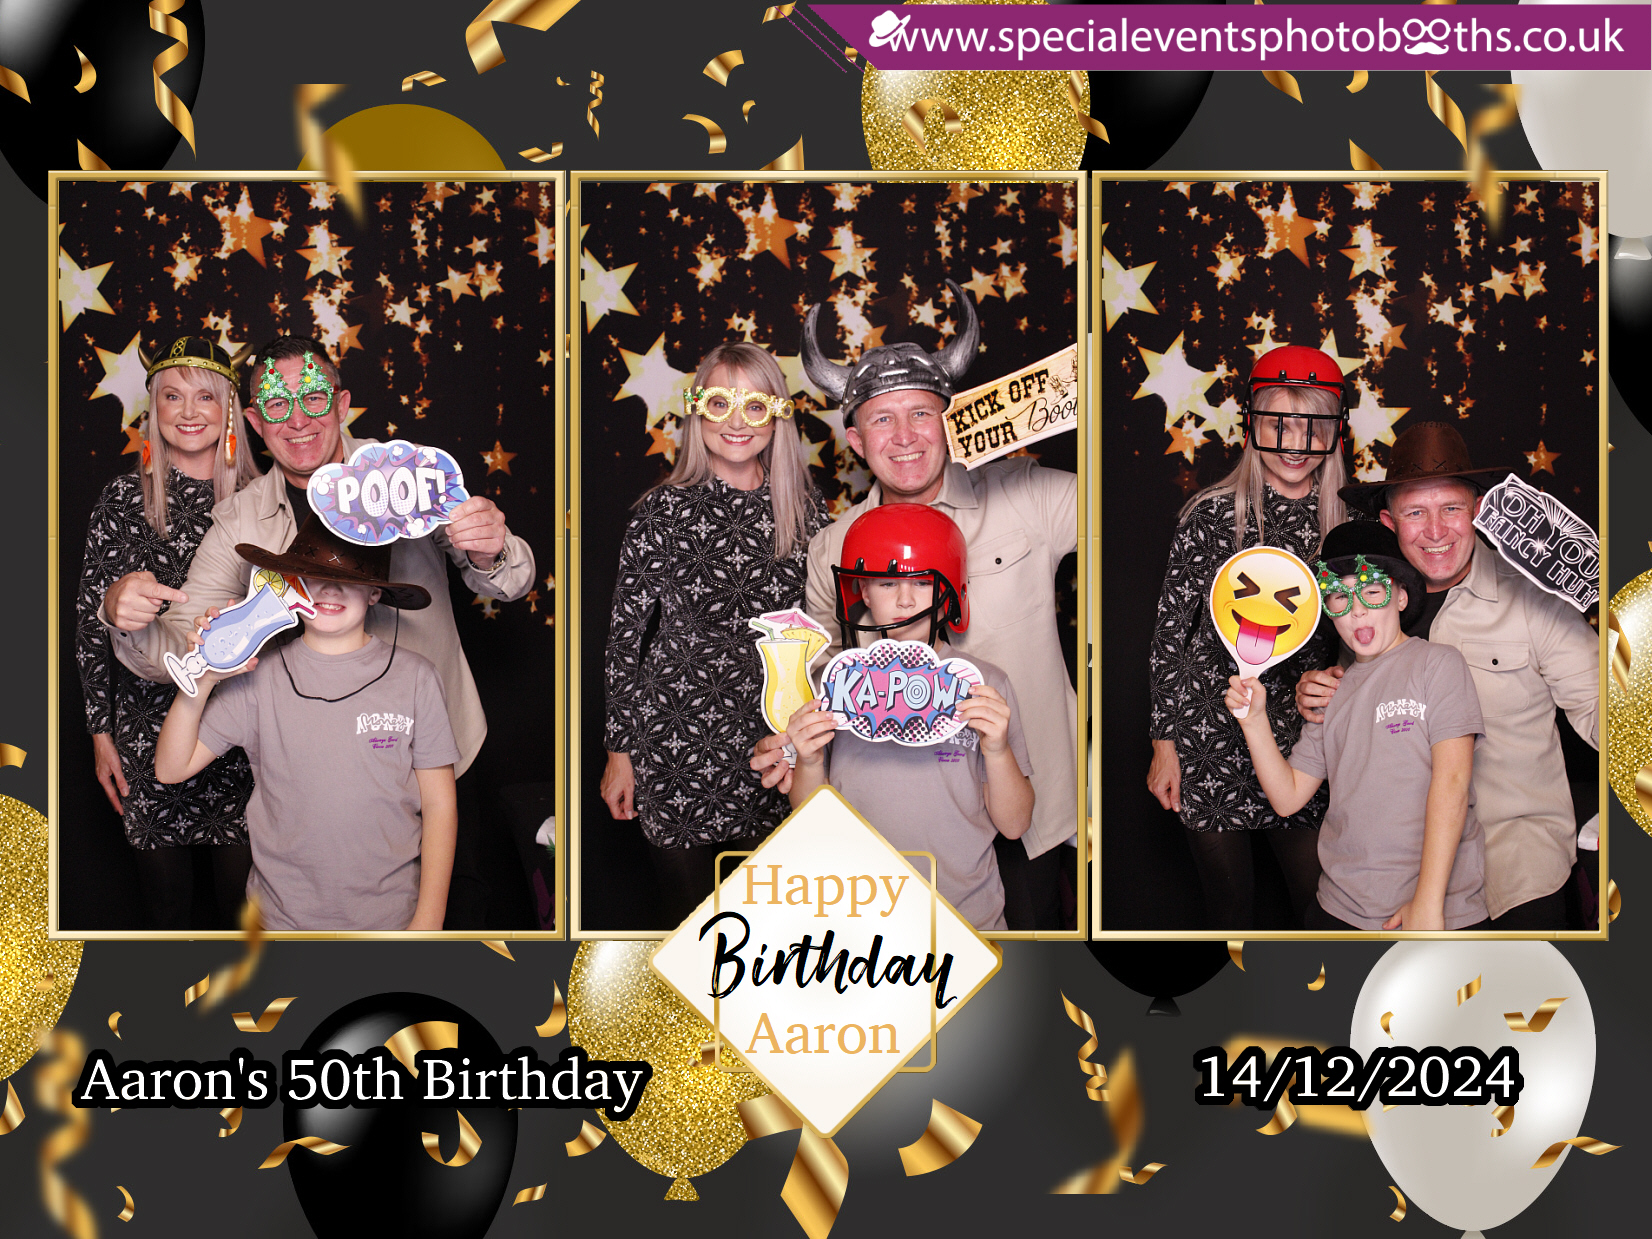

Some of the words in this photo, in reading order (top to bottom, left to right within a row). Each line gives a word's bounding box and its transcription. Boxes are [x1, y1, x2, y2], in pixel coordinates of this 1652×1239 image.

[950, 389, 1005, 435] KICK
[1008, 368, 1049, 404] OFF
[958, 421, 1018, 458] YOUR
[336, 466, 447, 518] POOF!
[1478, 504, 1552, 568] FANCY
[1546, 559, 1598, 609] HUH
[1501, 491, 1546, 534] OH
[1544, 523, 1599, 579] YOU
[831, 667, 973, 716] KA-POW!
